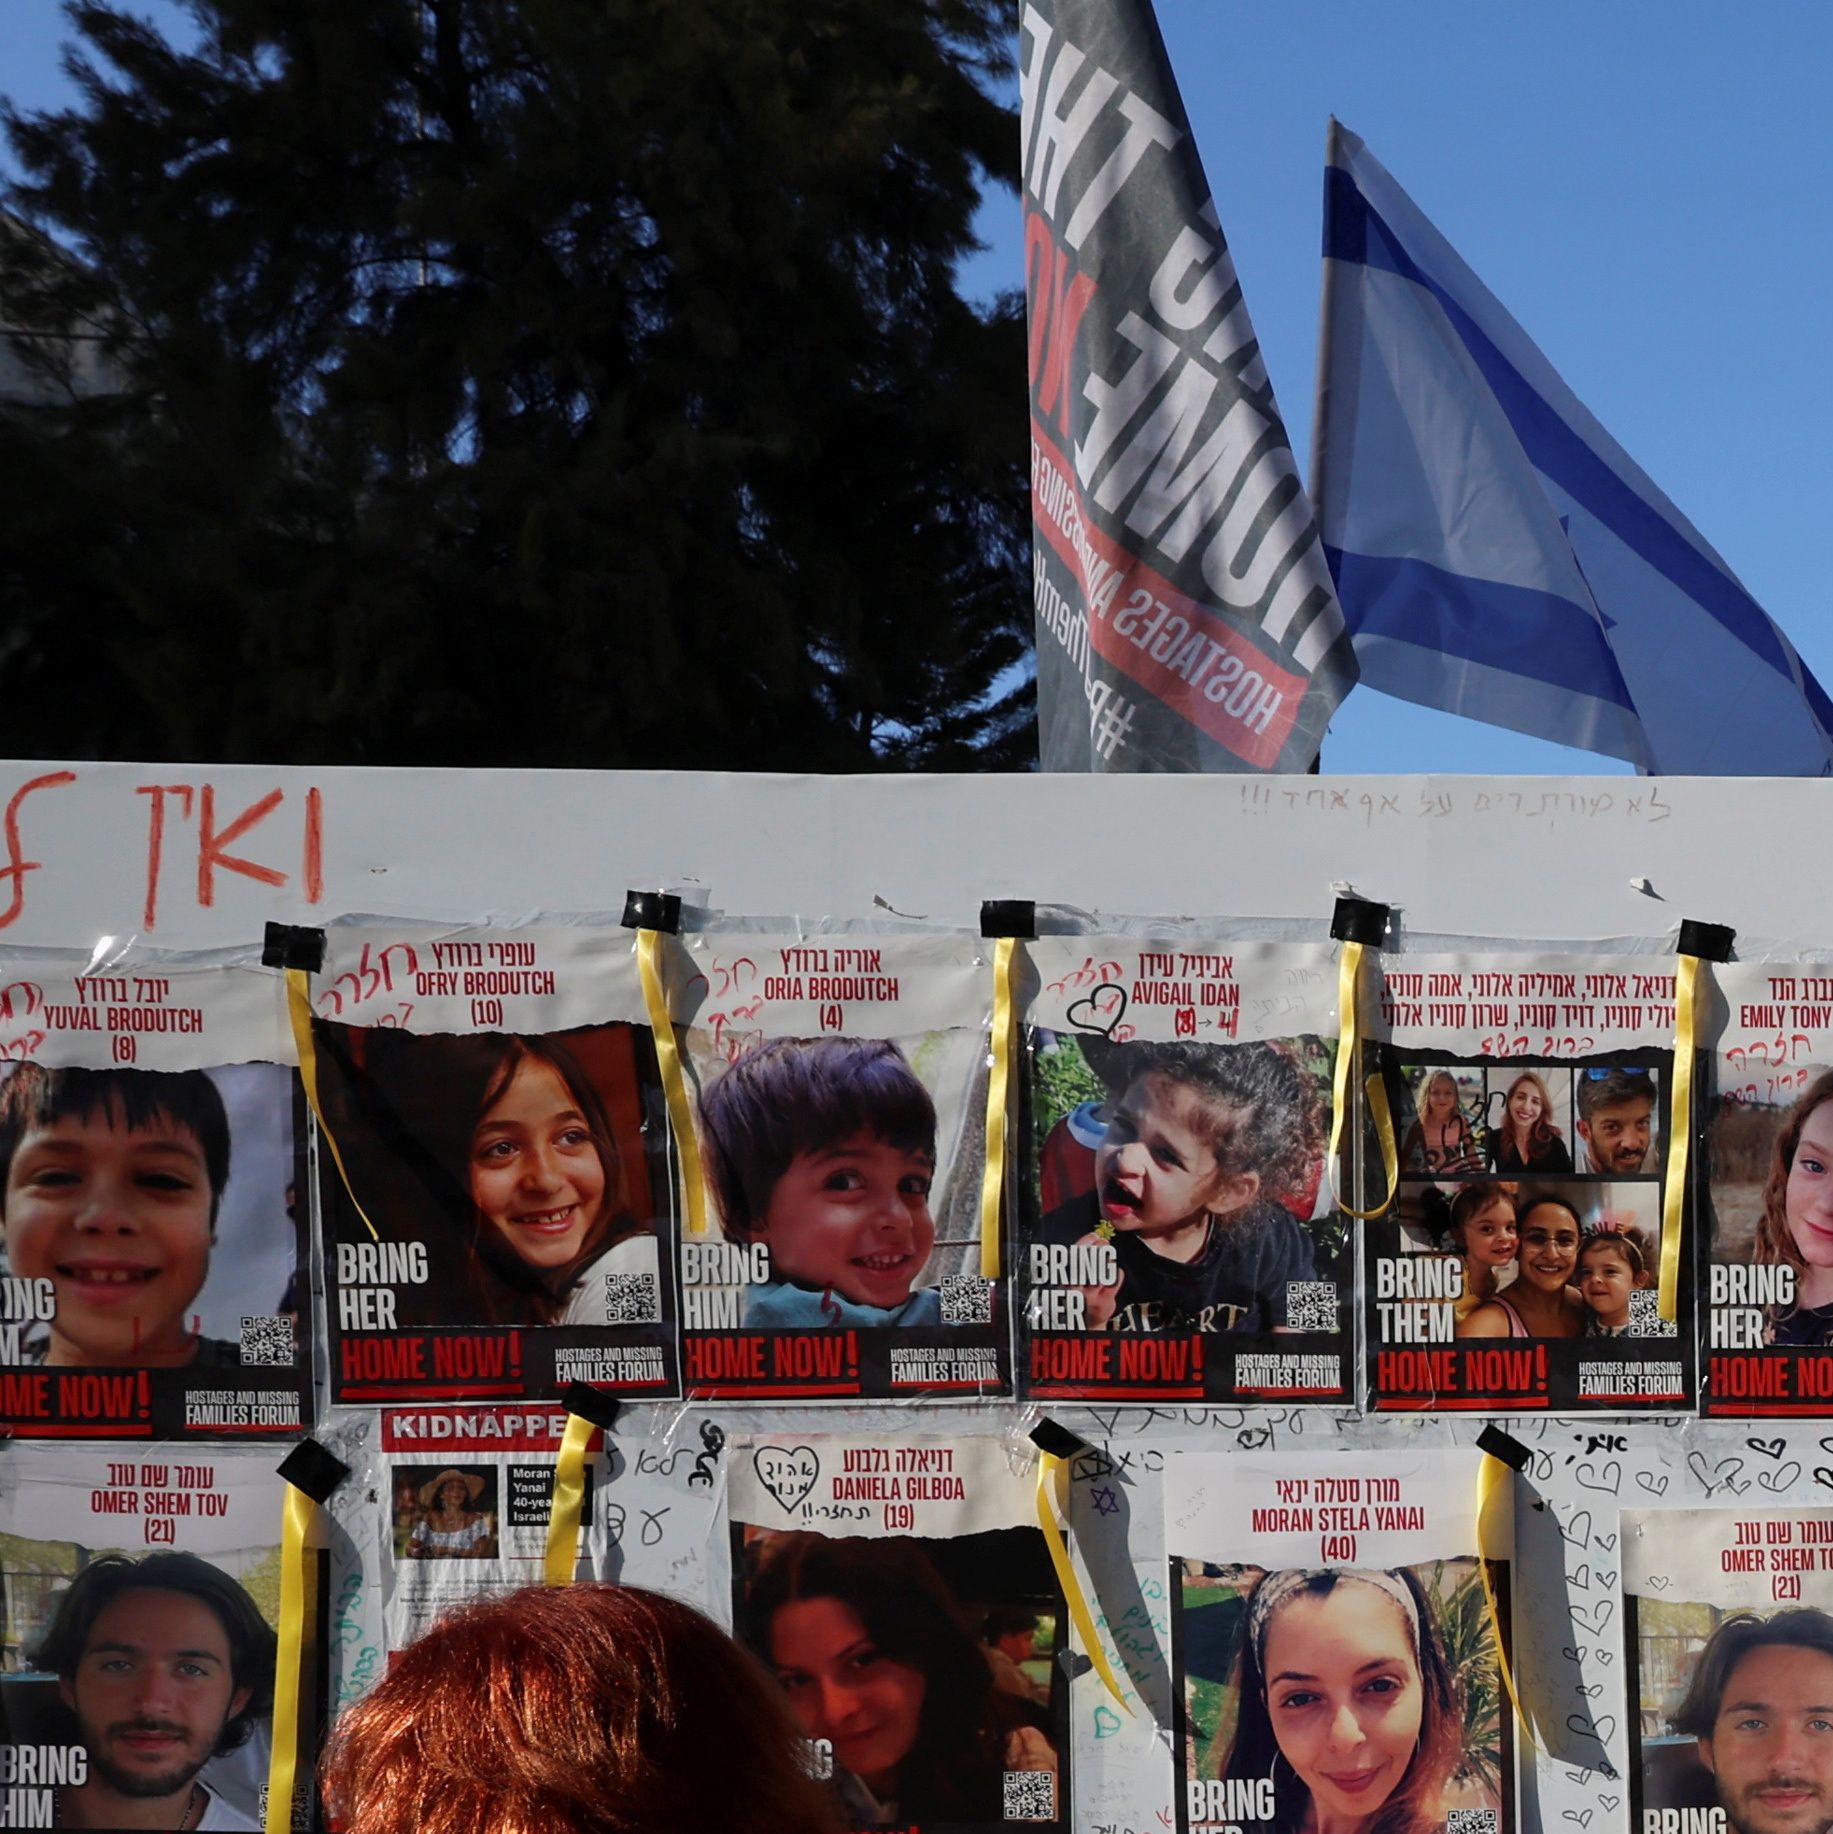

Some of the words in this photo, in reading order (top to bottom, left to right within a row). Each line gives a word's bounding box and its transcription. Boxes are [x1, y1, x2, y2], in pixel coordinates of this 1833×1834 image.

[76, 978, 127, 1003] ברודץ
[134, 978, 168, 1002] יובל
[417, 973, 456, 995] OFRY
[465, 972, 553, 994] BRODUTCH
[765, 978, 802, 999] ORIA
[810, 978, 897, 1000] BRODUTCH
[1133, 982, 1194, 1005] AVIGAIL
[1202, 984, 1238, 1005] IDAN
[44, 1007, 100, 1030] YUVAL
[108, 1008, 201, 1032] BRODUTCH
[472, 1000, 502, 1025] (10)
[1742, 1006, 1784, 1027] EMILY
[1794, 1006, 1830, 1027] TONY
[338, 1242, 428, 1284] BRING
[338, 1289, 396, 1330] HER
[1378, 1302, 1454, 1343] THEM
[342, 1336, 428, 1380] HOME
[436, 1332, 521, 1378] NOW!
[556, 1348, 598, 1362] HOSTAGES
[601, 1348, 619, 1361] AND
[621, 1347, 662, 1361] MISSING
[556, 1362, 614, 1382] FAMILIES
[619, 1362, 664, 1382] FORUM
[393, 1415, 566, 1438] KIDNAPPE
[513, 1469, 550, 1478] Moran
[513, 1483, 546, 1493] Yanai
[834, 1478, 900, 1499] DANIELA
[907, 1478, 964, 1499] GILBOA
[93, 1491, 137, 1512] OMER
[145, 1493, 189, 1514] SHEM
[197, 1494, 227, 1516] TOV
[1253, 1509, 1301, 1531] MORAN
[1308, 1508, 1369, 1532] STELA
[1376, 1508, 1423, 1529] YANAI
